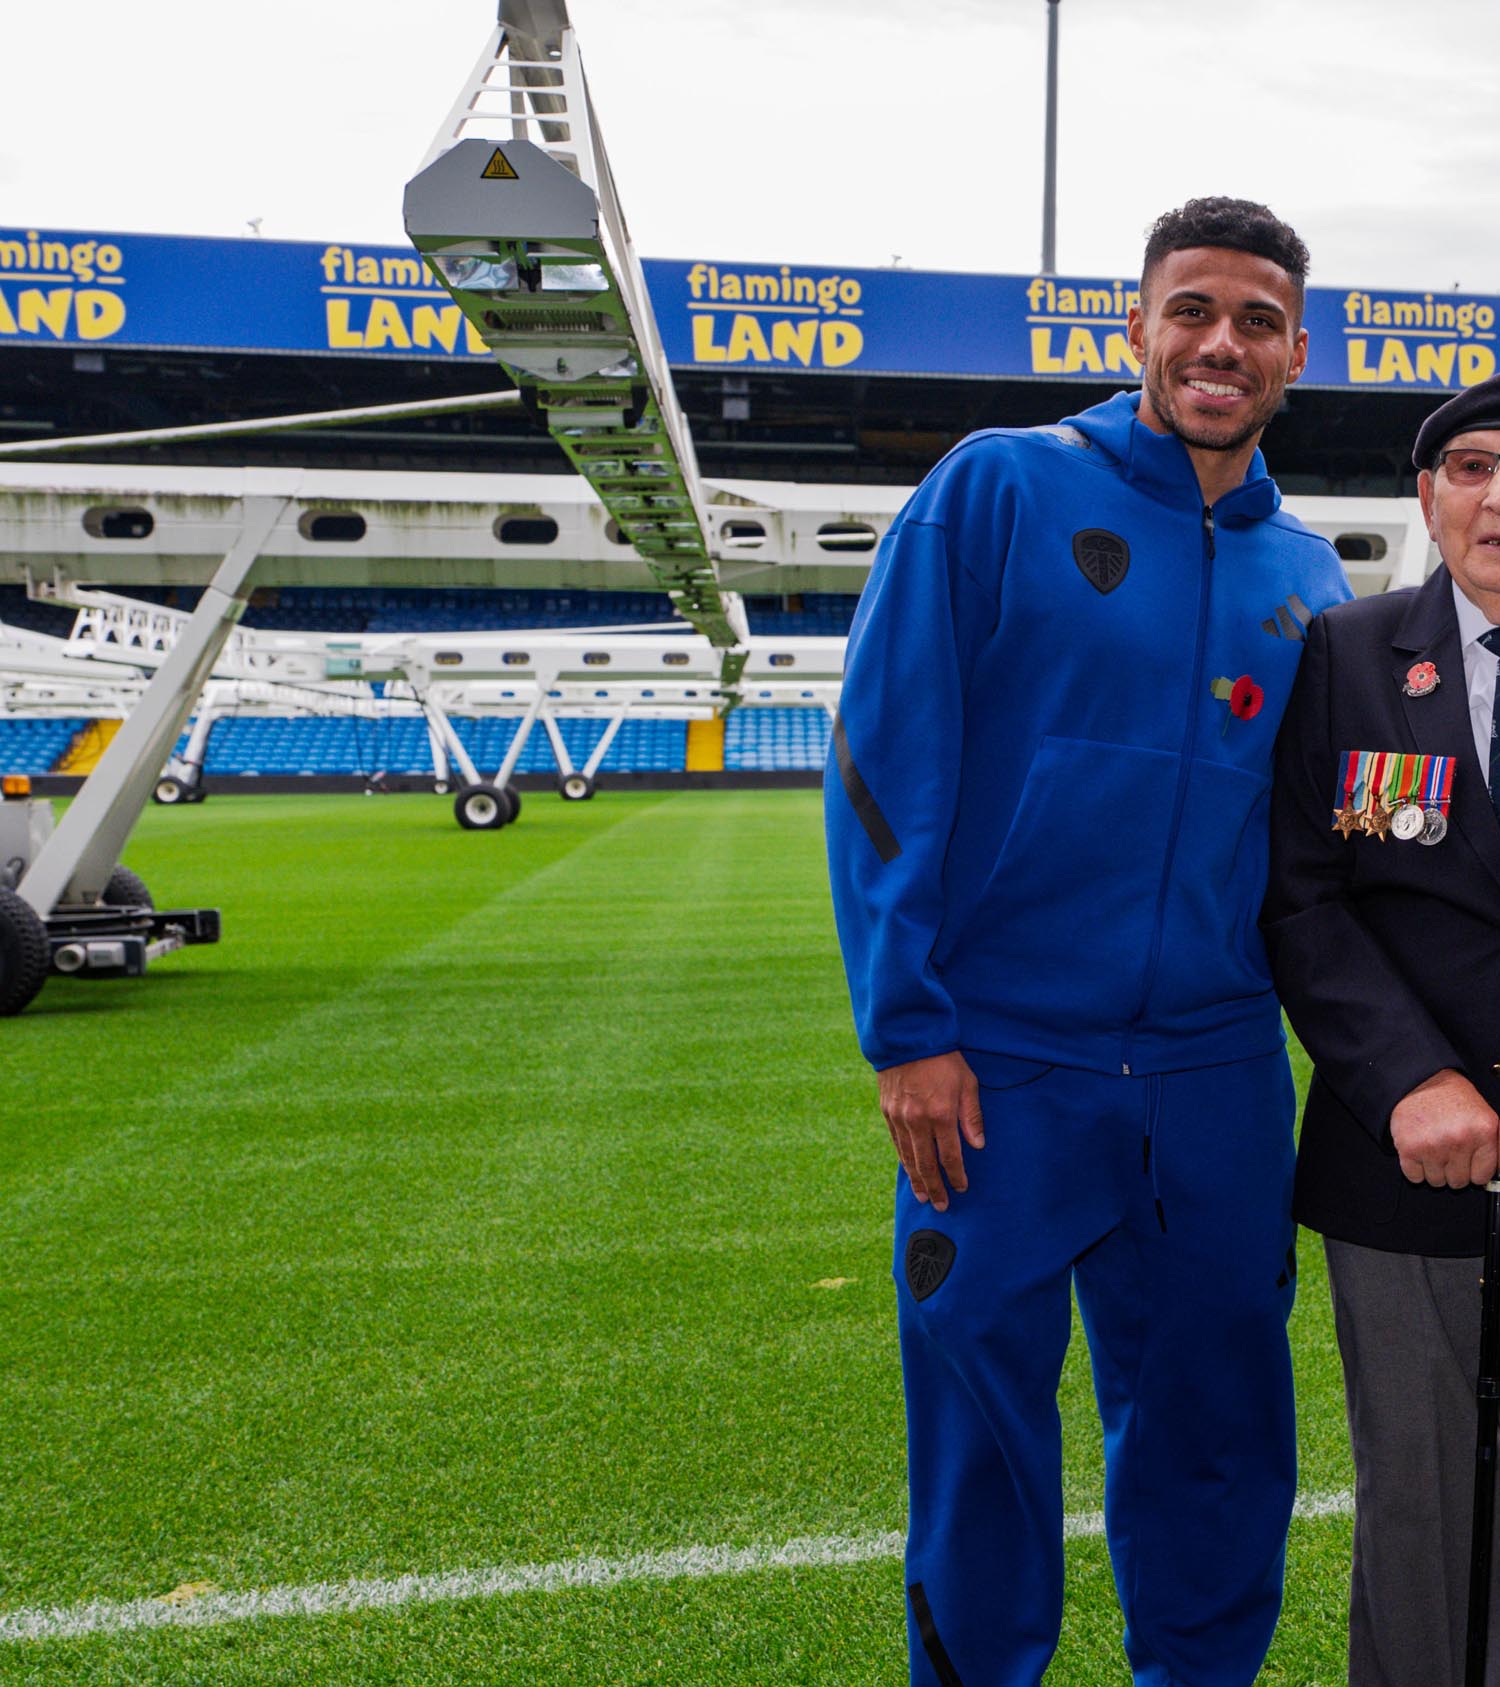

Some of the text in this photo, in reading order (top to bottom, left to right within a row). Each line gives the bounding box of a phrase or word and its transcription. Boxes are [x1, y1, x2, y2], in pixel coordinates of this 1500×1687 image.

[0, 230, 123, 282] mingo
[320, 246, 444, 287] flami
[0, 287, 126, 340] ND
[687, 263, 862, 314] flamingo
[692, 313, 864, 367] LAND
[1343, 291, 1495, 338] flamingo
[1030, 326, 1142, 378] LAN
[1347, 337, 1496, 387] LAND
